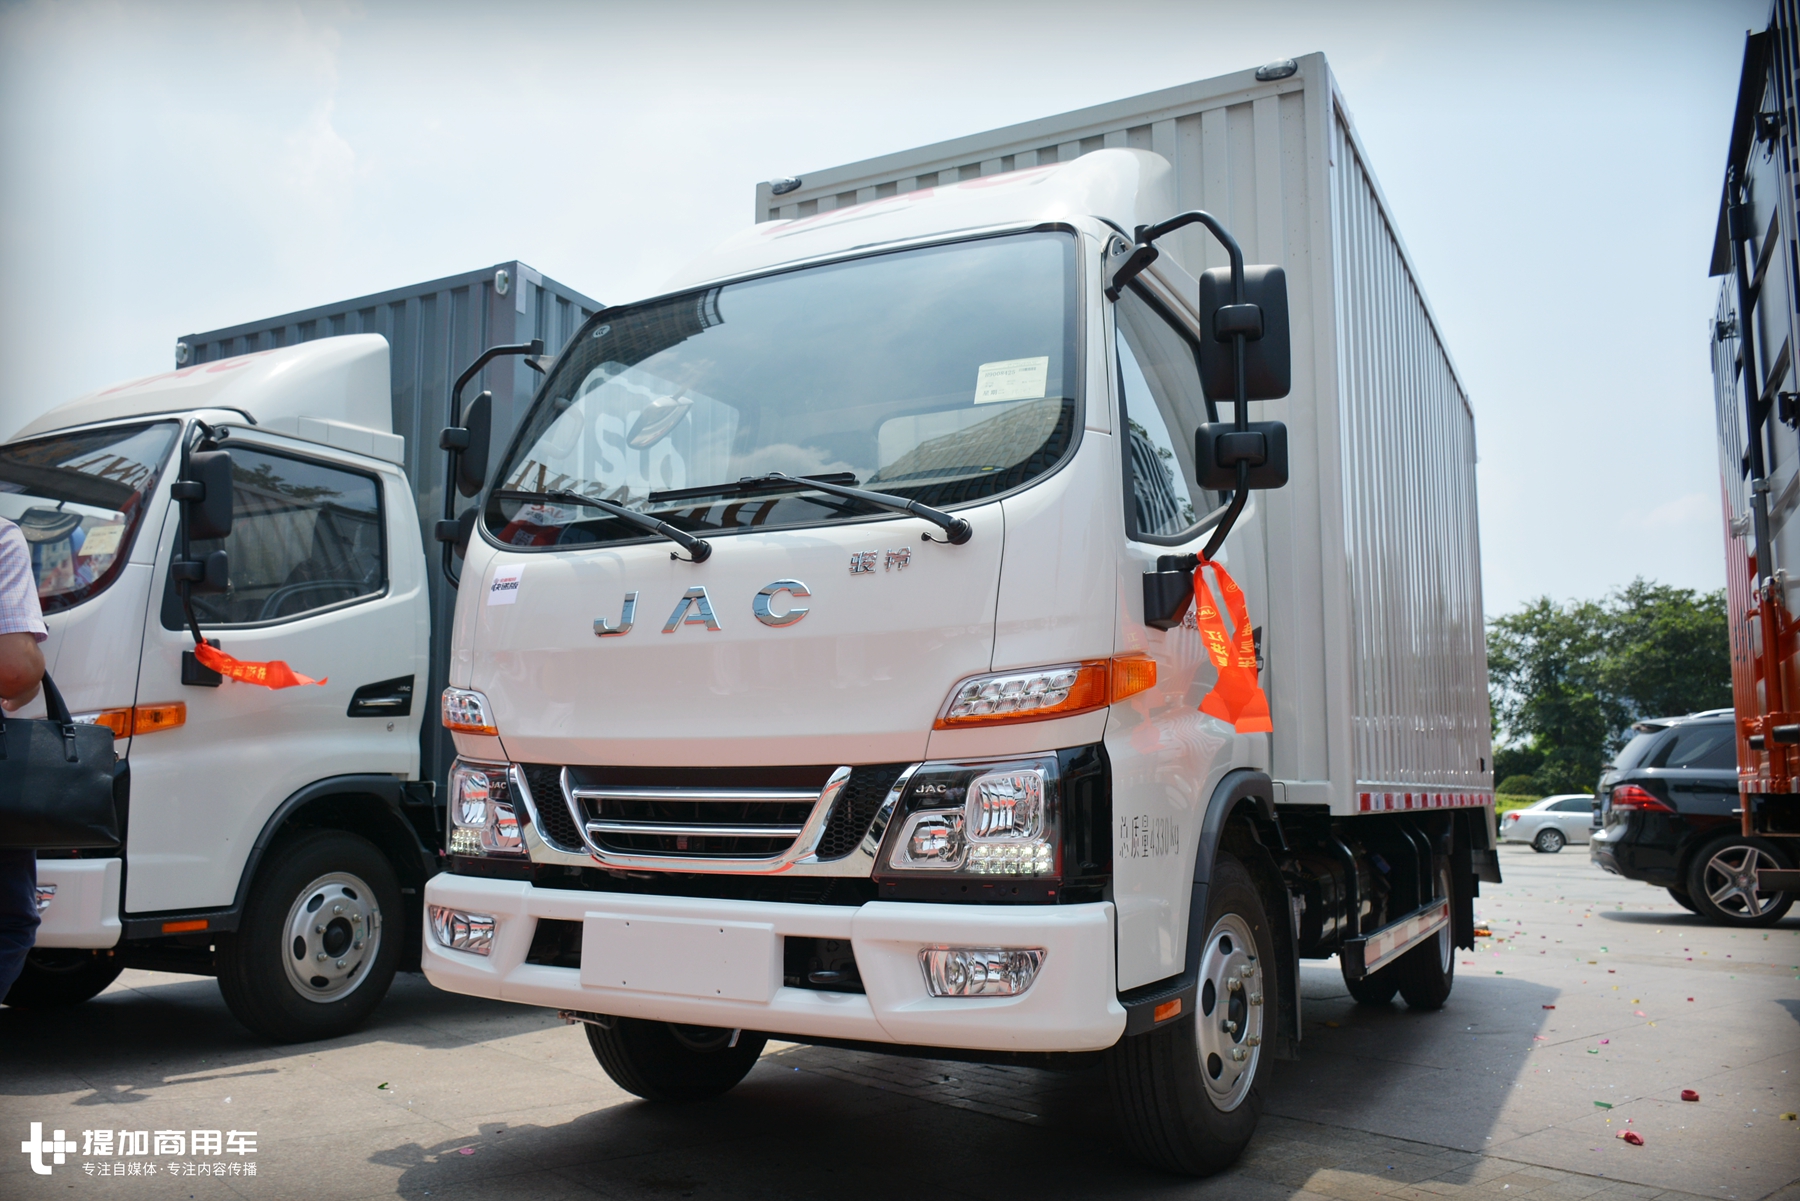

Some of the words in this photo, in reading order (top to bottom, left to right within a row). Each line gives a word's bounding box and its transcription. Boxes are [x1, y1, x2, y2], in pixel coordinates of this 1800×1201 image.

[593, 578, 811, 638] JAC
[489, 781, 507, 790] JAC
[915, 784, 947, 794] JAC
